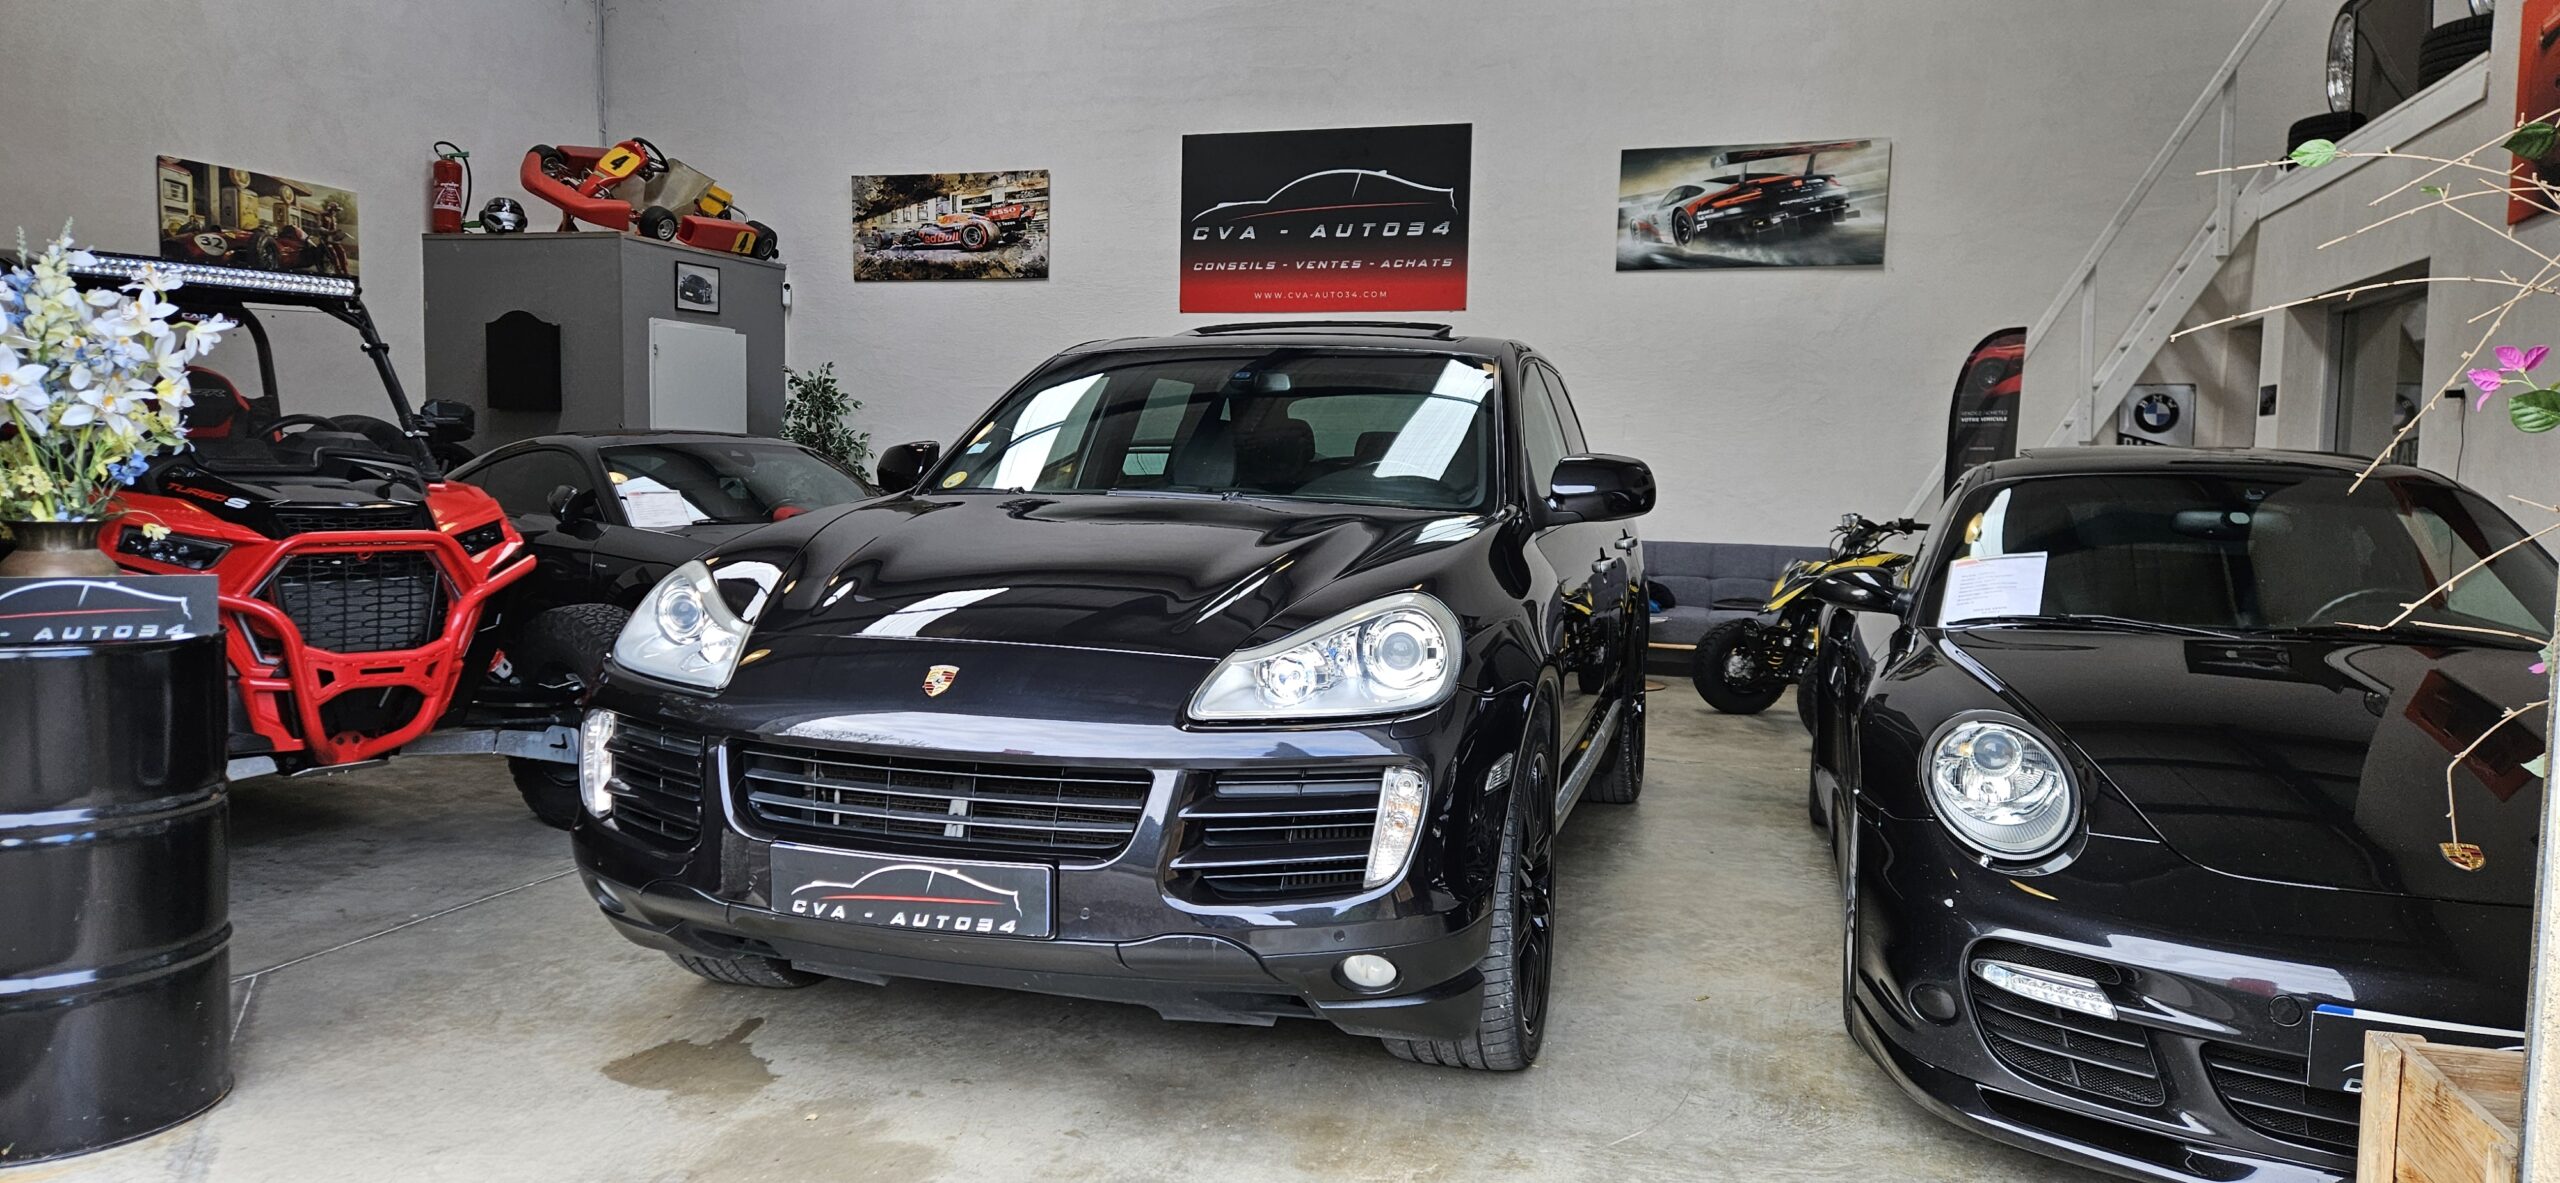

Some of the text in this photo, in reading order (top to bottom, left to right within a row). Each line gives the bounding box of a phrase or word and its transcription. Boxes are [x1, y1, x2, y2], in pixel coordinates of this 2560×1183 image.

[611, 155, 629, 170] 4
[992, 207, 1017, 216] ESSO
[1192, 226, 1256, 241] CVA
[1309, 220, 1451, 239] AUTO34
[200, 235, 225, 249] 32
[738, 233, 750, 252] 4
[1193, 261, 1276, 271] CONSEILS
[1295, 260, 1363, 270] VENTES
[1380, 258, 1454, 269] ACHATS
[1253, 290, 1388, 300] WWW.CVA-AUTO34.COM
[2139, 394, 2178, 409] BMW
[167, 482, 250, 509] TURBO S
[33, 623, 186, 641] AUTO34
[791, 899, 846, 920] CVA
[889, 911, 1017, 933] AUTO34
